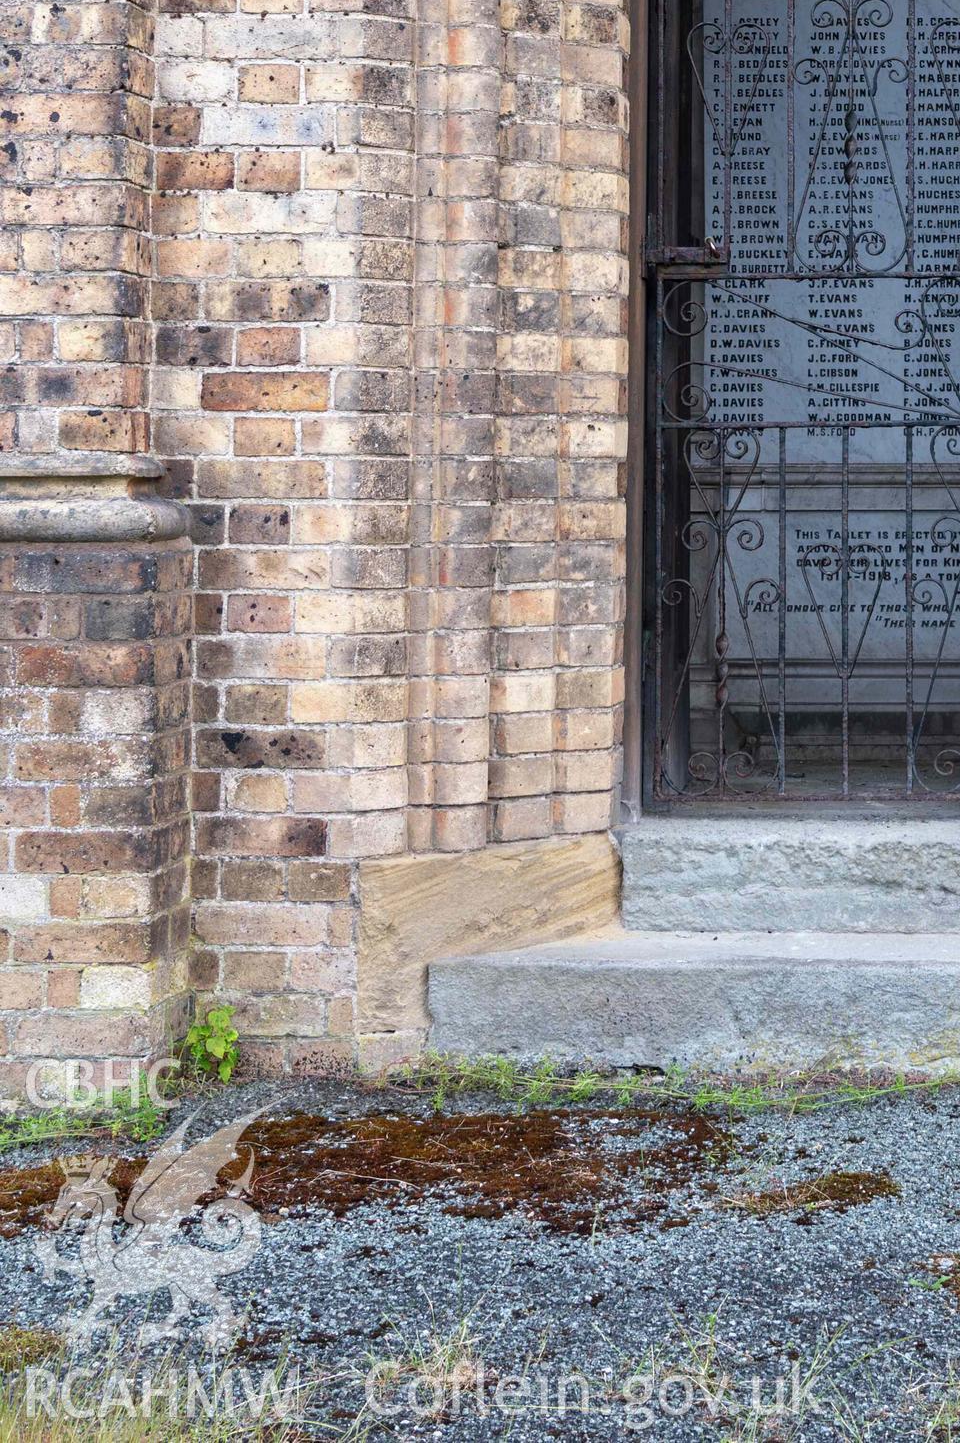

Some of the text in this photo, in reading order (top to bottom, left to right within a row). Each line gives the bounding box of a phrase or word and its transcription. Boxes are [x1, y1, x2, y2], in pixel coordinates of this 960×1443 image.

[810, 32, 839, 41] JOHN
[712, 46, 789, 55] ..BANFIELD
[713, 60, 789, 69] R..BEDDOES
[713, 75, 786, 83] R..BEEDLES
[713, 89, 784, 98] T..BEEDLES
[713, 103, 776, 112] C.ENNETT
[713, 118, 763, 127] C.EVAN
[809, 133, 871, 141] J.E.EVNS
[712, 147, 771, 156] C..BRAY
[808, 147, 878, 156] E.EDWRDS
[808, 161, 887, 170] .S.EDARDS
[712, 176, 767, 185] E.REESE
[712, 191, 777, 199] J..BREESE
[809, 191, 874, 199] A.E.EVANS
[905, 191, 960, 199] .HUGHES
[808, 205, 873, 214] A.R.EVANS
[712, 220, 780, 229] C..BROWN
[712, 235, 784, 244] WE.BROWN
[847, 235, 885, 244] VANS
[808, 265, 861, 274] HEVANS
[808, 279, 875, 289] J.P.EVANS
[808, 294, 857, 303] T.EVANS
[808, 309, 863, 318] W.EVANS
[904, 339, 951, 348] BJONES
[710, 354, 764, 363] E.DAVIES
[904, 369, 950, 378] E.JONES
[709, 398, 764, 407] H.DAVIES
[904, 398, 950, 407] F.JONES
[710, 413, 764, 422] J.DAVIES
[807, 428, 856, 437] M.S.FOD
[795, 529, 820, 540] THIS
[826, 529, 871, 540] TALET
[878, 531, 889, 540] IS
[834, 557, 871, 567] TEIR
[873, 557, 907, 567] LIVES
[915, 558, 938, 567] FOR
[820, 571, 898, 585] 191-1918,
[778, 604, 824, 613] ONOUR
[921, 620, 956, 629] NAME
